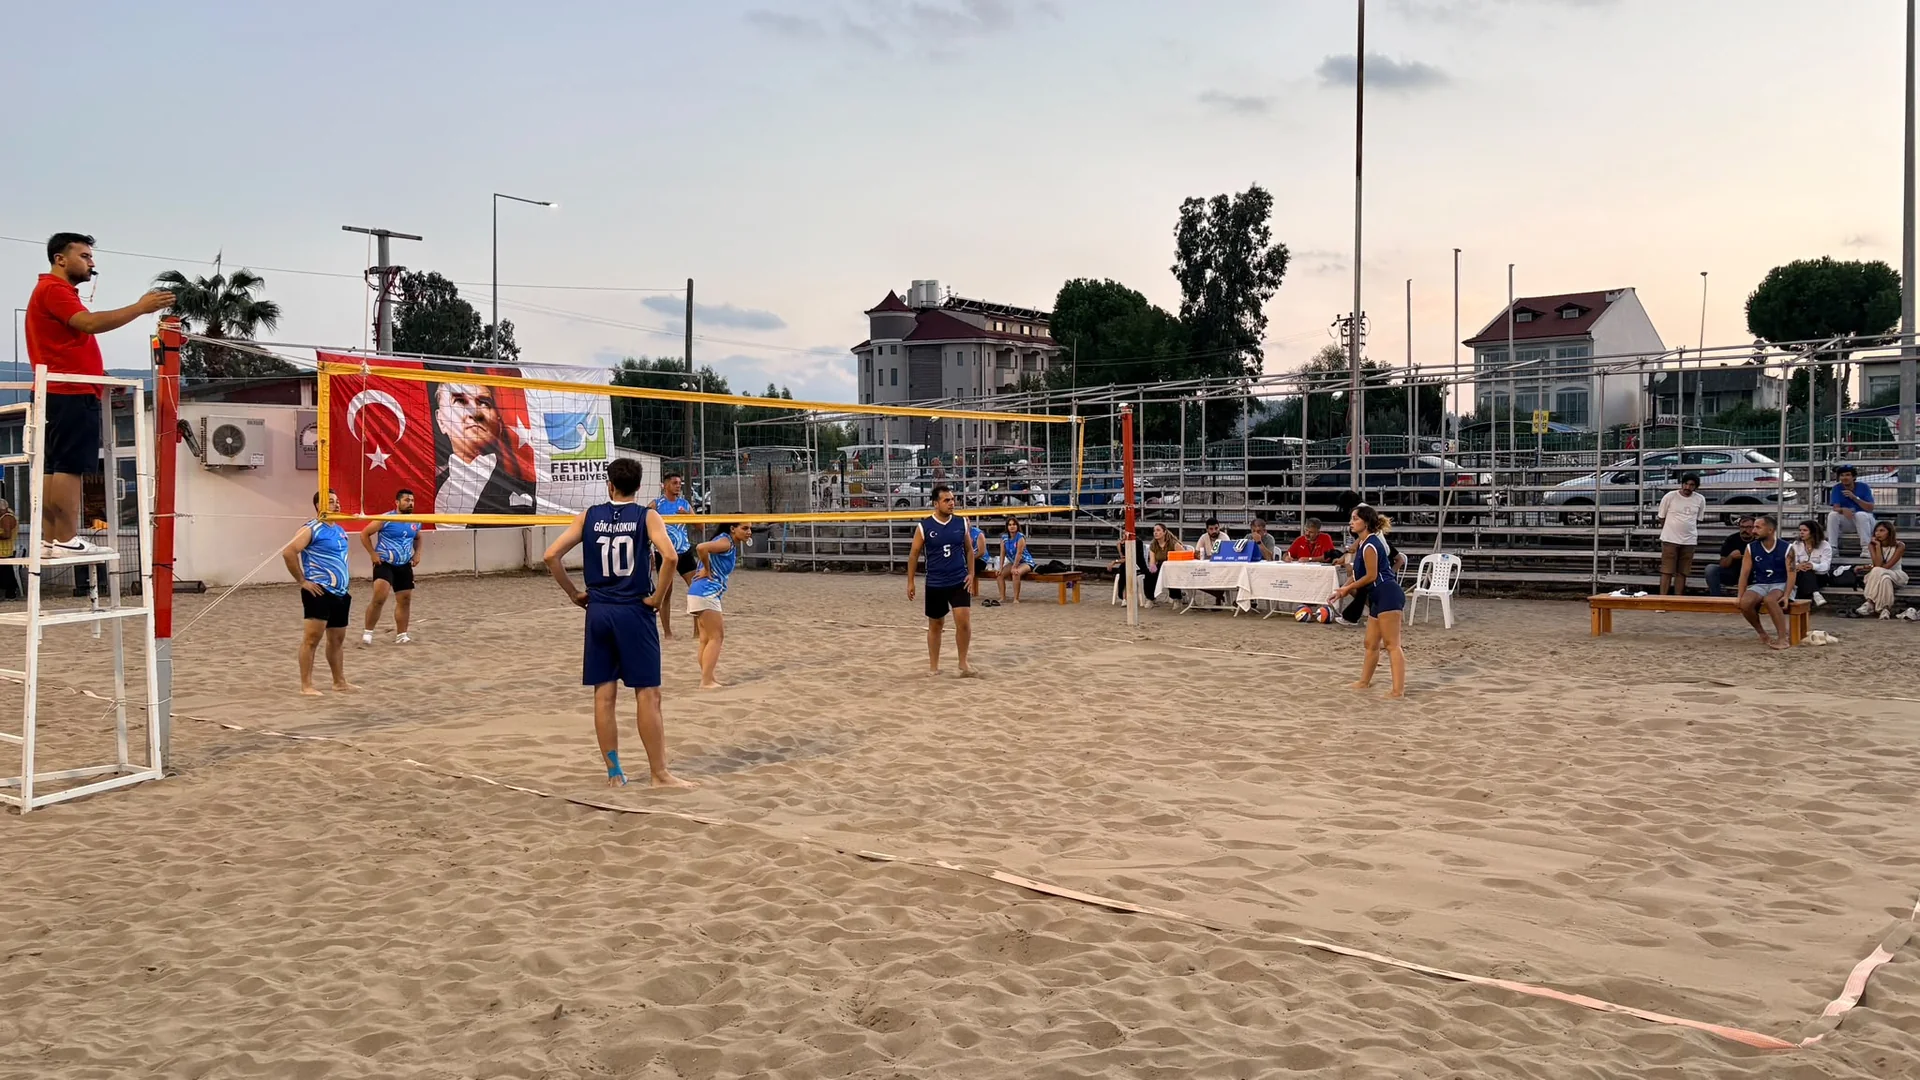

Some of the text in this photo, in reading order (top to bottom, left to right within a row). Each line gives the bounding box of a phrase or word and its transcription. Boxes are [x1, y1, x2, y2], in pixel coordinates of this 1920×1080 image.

[550, 460, 609, 474] FETHİYE
[551, 473, 608, 482] BELEDİYES
[596, 535, 635, 577] 10
[943, 544, 951, 558] 5
[1765, 569, 1774, 578] 7
